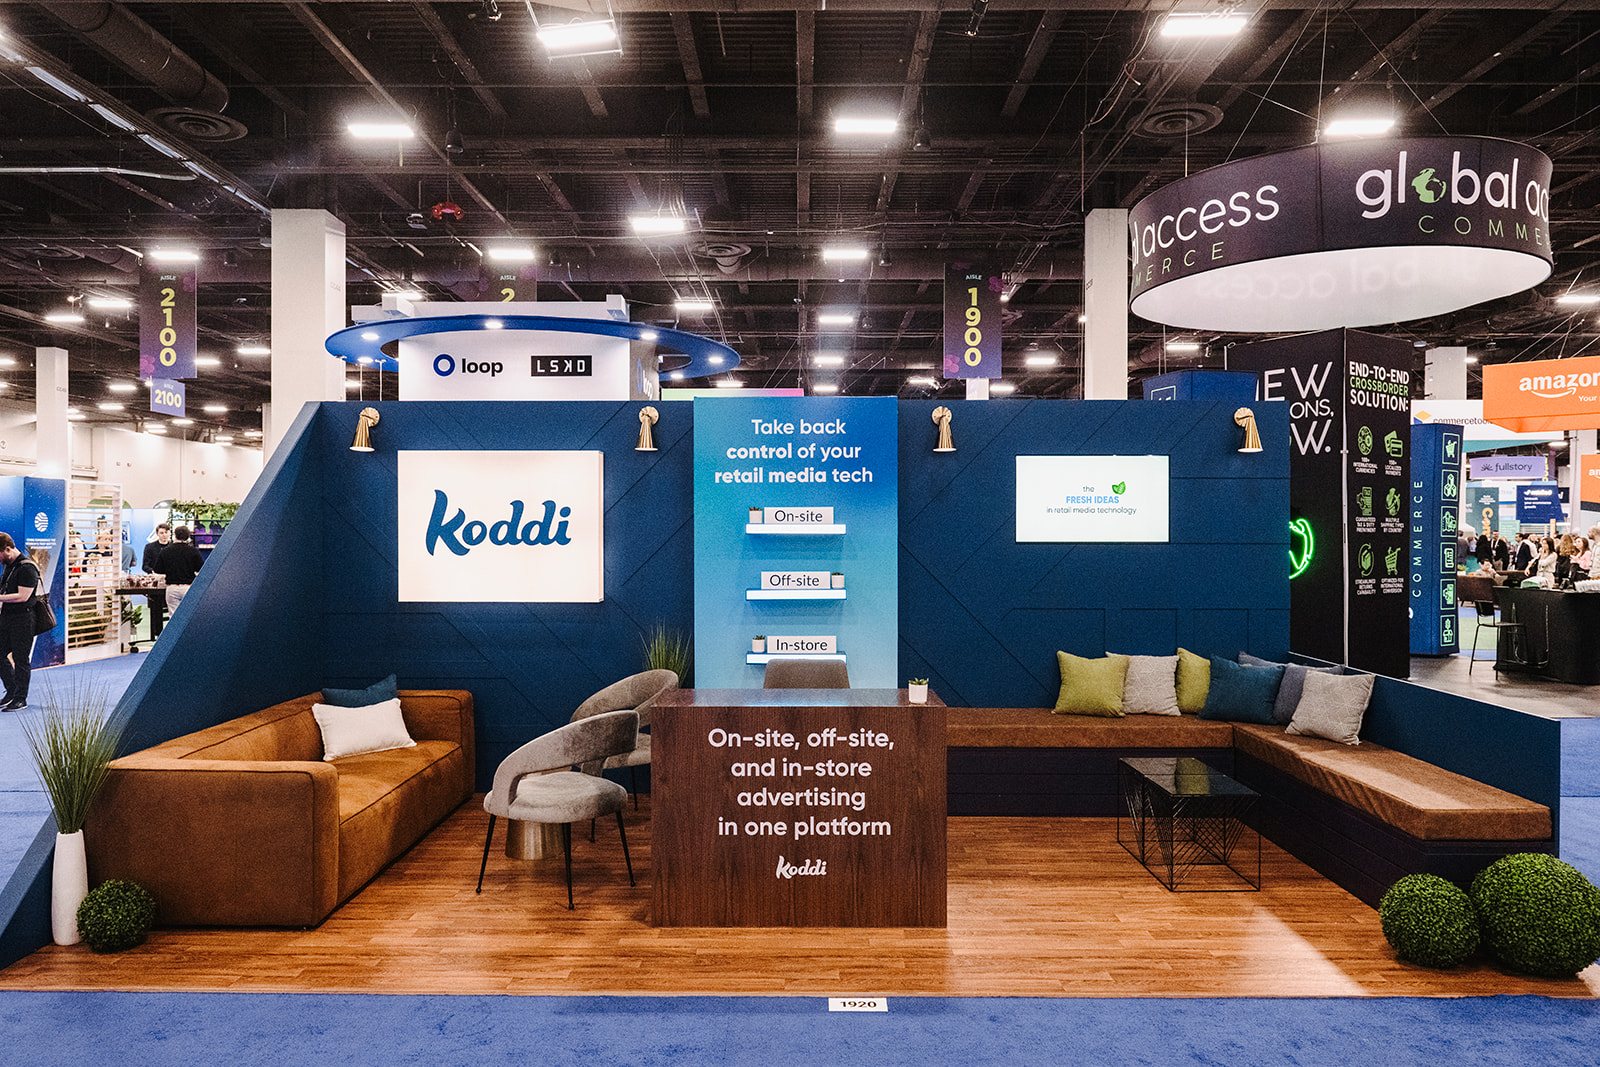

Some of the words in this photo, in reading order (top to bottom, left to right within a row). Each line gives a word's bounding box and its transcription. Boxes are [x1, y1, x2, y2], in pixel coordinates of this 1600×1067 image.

[1142, 184, 1280, 258] access
[1418, 215, 1549, 246] COMME
[159, 287, 177, 367] 2100
[964, 287, 982, 367] 1900
[461, 358, 504, 377] loop
[1349, 361, 1410, 385] END-TO-END
[1349, 376, 1409, 397] CROSSBORDER
[154, 388, 182, 408] 2100
[1350, 388, 1409, 412] SOLUTION:
[1578, 394, 1597, 402] Your
[1289, 398, 1334, 419] ONS,
[751, 419, 795, 435] Take
[799, 419, 846, 435] back
[1289, 419, 1332, 456] W.
[726, 443, 793, 459] control
[797, 443, 816, 459] of
[819, 446, 861, 462] your
[714, 467, 764, 483] retail
[768, 467, 827, 483] media
[832, 467, 873, 483] tech
[1495, 462, 1533, 472] fullstory
[1066, 496, 1092, 504] FRESH
[1094, 496, 1120, 504] IDEAS
[774, 510, 823, 522] On-site
[1097, 506, 1137, 515] technology
[1412, 481, 1423, 598] COMMERCE
[769, 574, 820, 586] Off-site
[776, 639, 828, 651] In-store
[708, 728, 800, 750] On-site,
[807, 728, 895, 750] off-site,
[731, 758, 775, 777] and
[782, 758, 872, 777] in-store
[737, 787, 866, 810] advertising
[718, 817, 738, 836] in
[744, 820, 787, 836] one
[794, 816, 891, 840] platform
